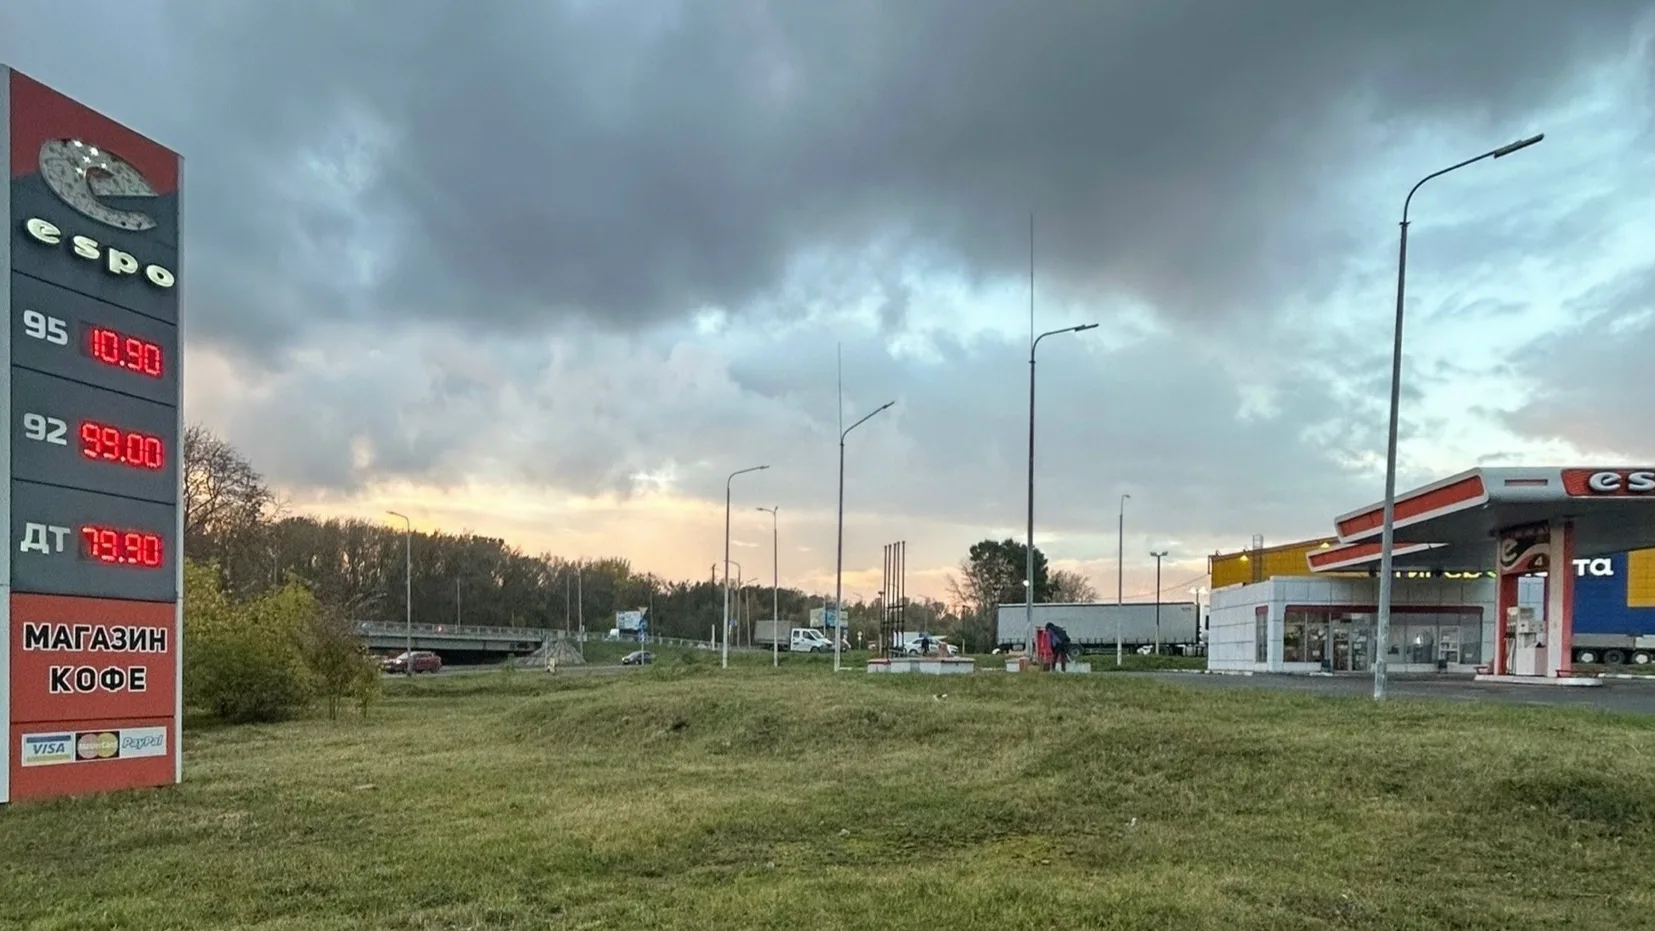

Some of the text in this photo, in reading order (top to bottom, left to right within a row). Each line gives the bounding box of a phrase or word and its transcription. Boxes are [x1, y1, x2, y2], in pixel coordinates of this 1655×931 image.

[27, 218, 175, 287] espo
[24, 310, 160, 375] 95 10.90
[24, 412, 161, 468] 92 99.00
[20, 522, 159, 565] ДТ 79.90
[24, 623, 167, 652] МАГАЗИН
[50, 666, 147, 693] КОФЕ
[33, 743, 66, 754] VISA
[122, 734, 164, 750] PayPal
